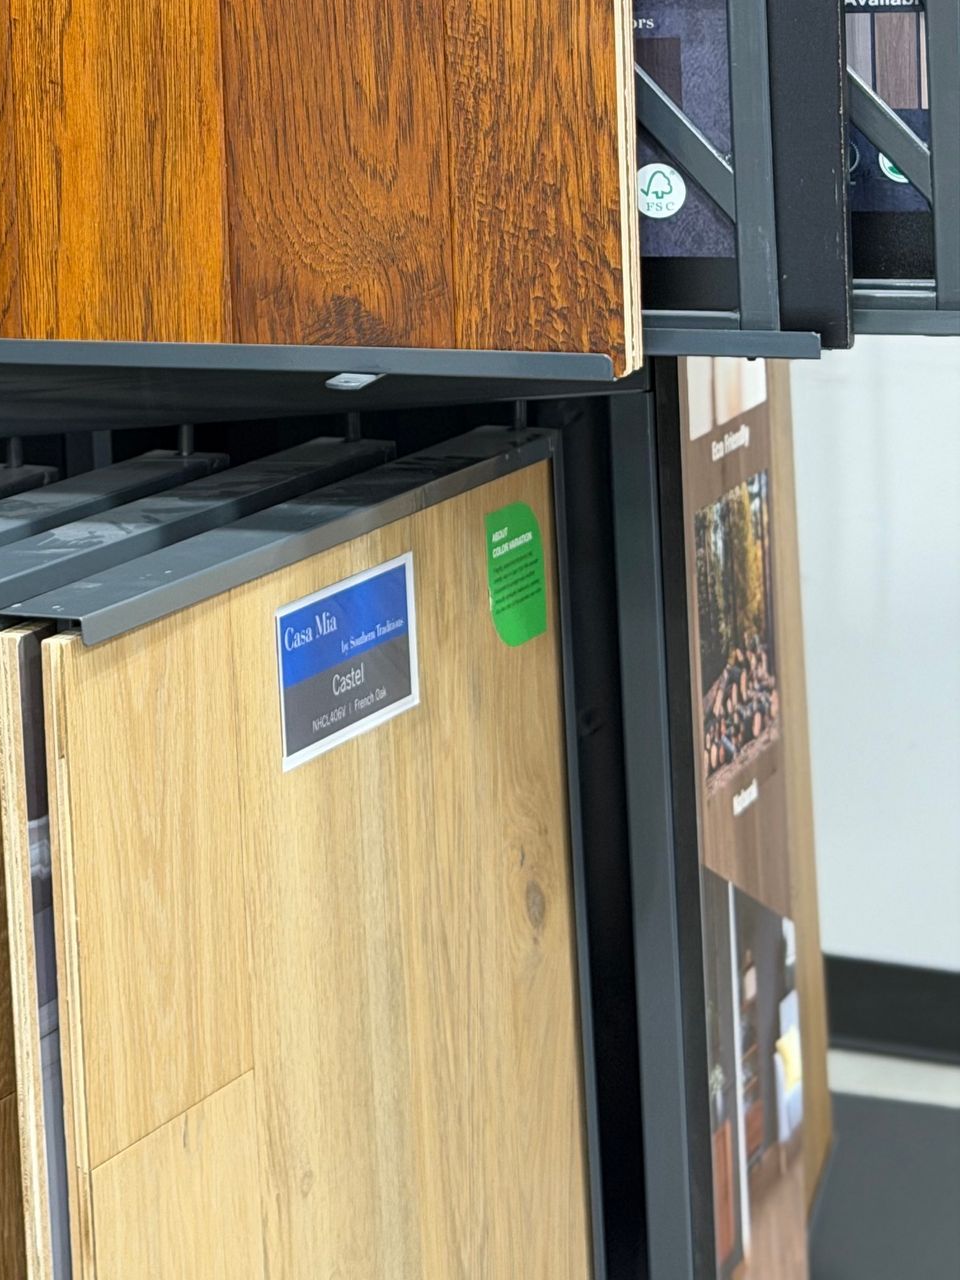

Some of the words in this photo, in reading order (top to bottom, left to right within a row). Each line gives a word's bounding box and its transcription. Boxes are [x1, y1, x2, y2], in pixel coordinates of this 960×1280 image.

[284, 625, 313, 652] Casa
[315, 611, 338, 640] Mia
[341, 639, 349, 656] by
[349, 631, 376, 649] Southern
[332, 662, 364, 696] Castel
[354, 691, 374, 711] French
[375, 685, 387, 701] Oak
